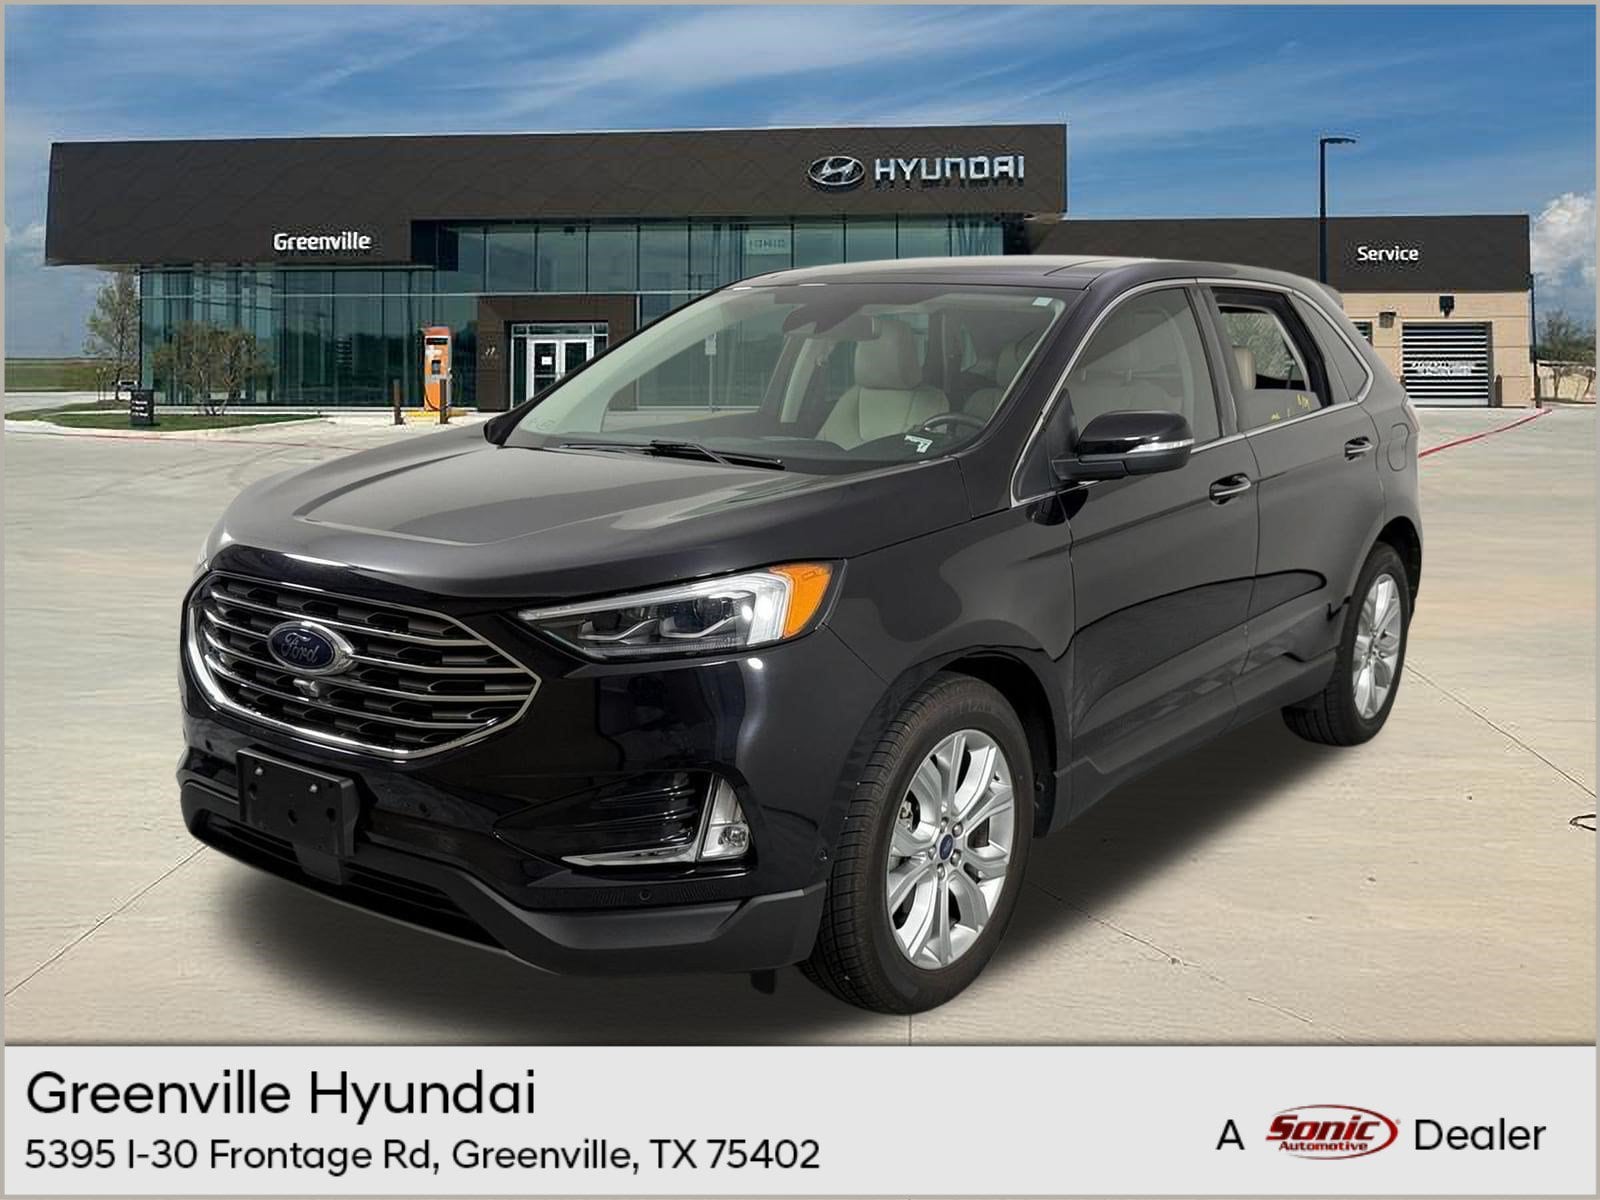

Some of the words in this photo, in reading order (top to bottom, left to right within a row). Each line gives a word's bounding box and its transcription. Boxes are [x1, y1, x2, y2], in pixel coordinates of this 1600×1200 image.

[874, 155, 1025, 181] HYUNDAI
[273, 231, 372, 251] Greenville
[1356, 245, 1419, 261] Service
[281, 632, 320, 663] Ford
